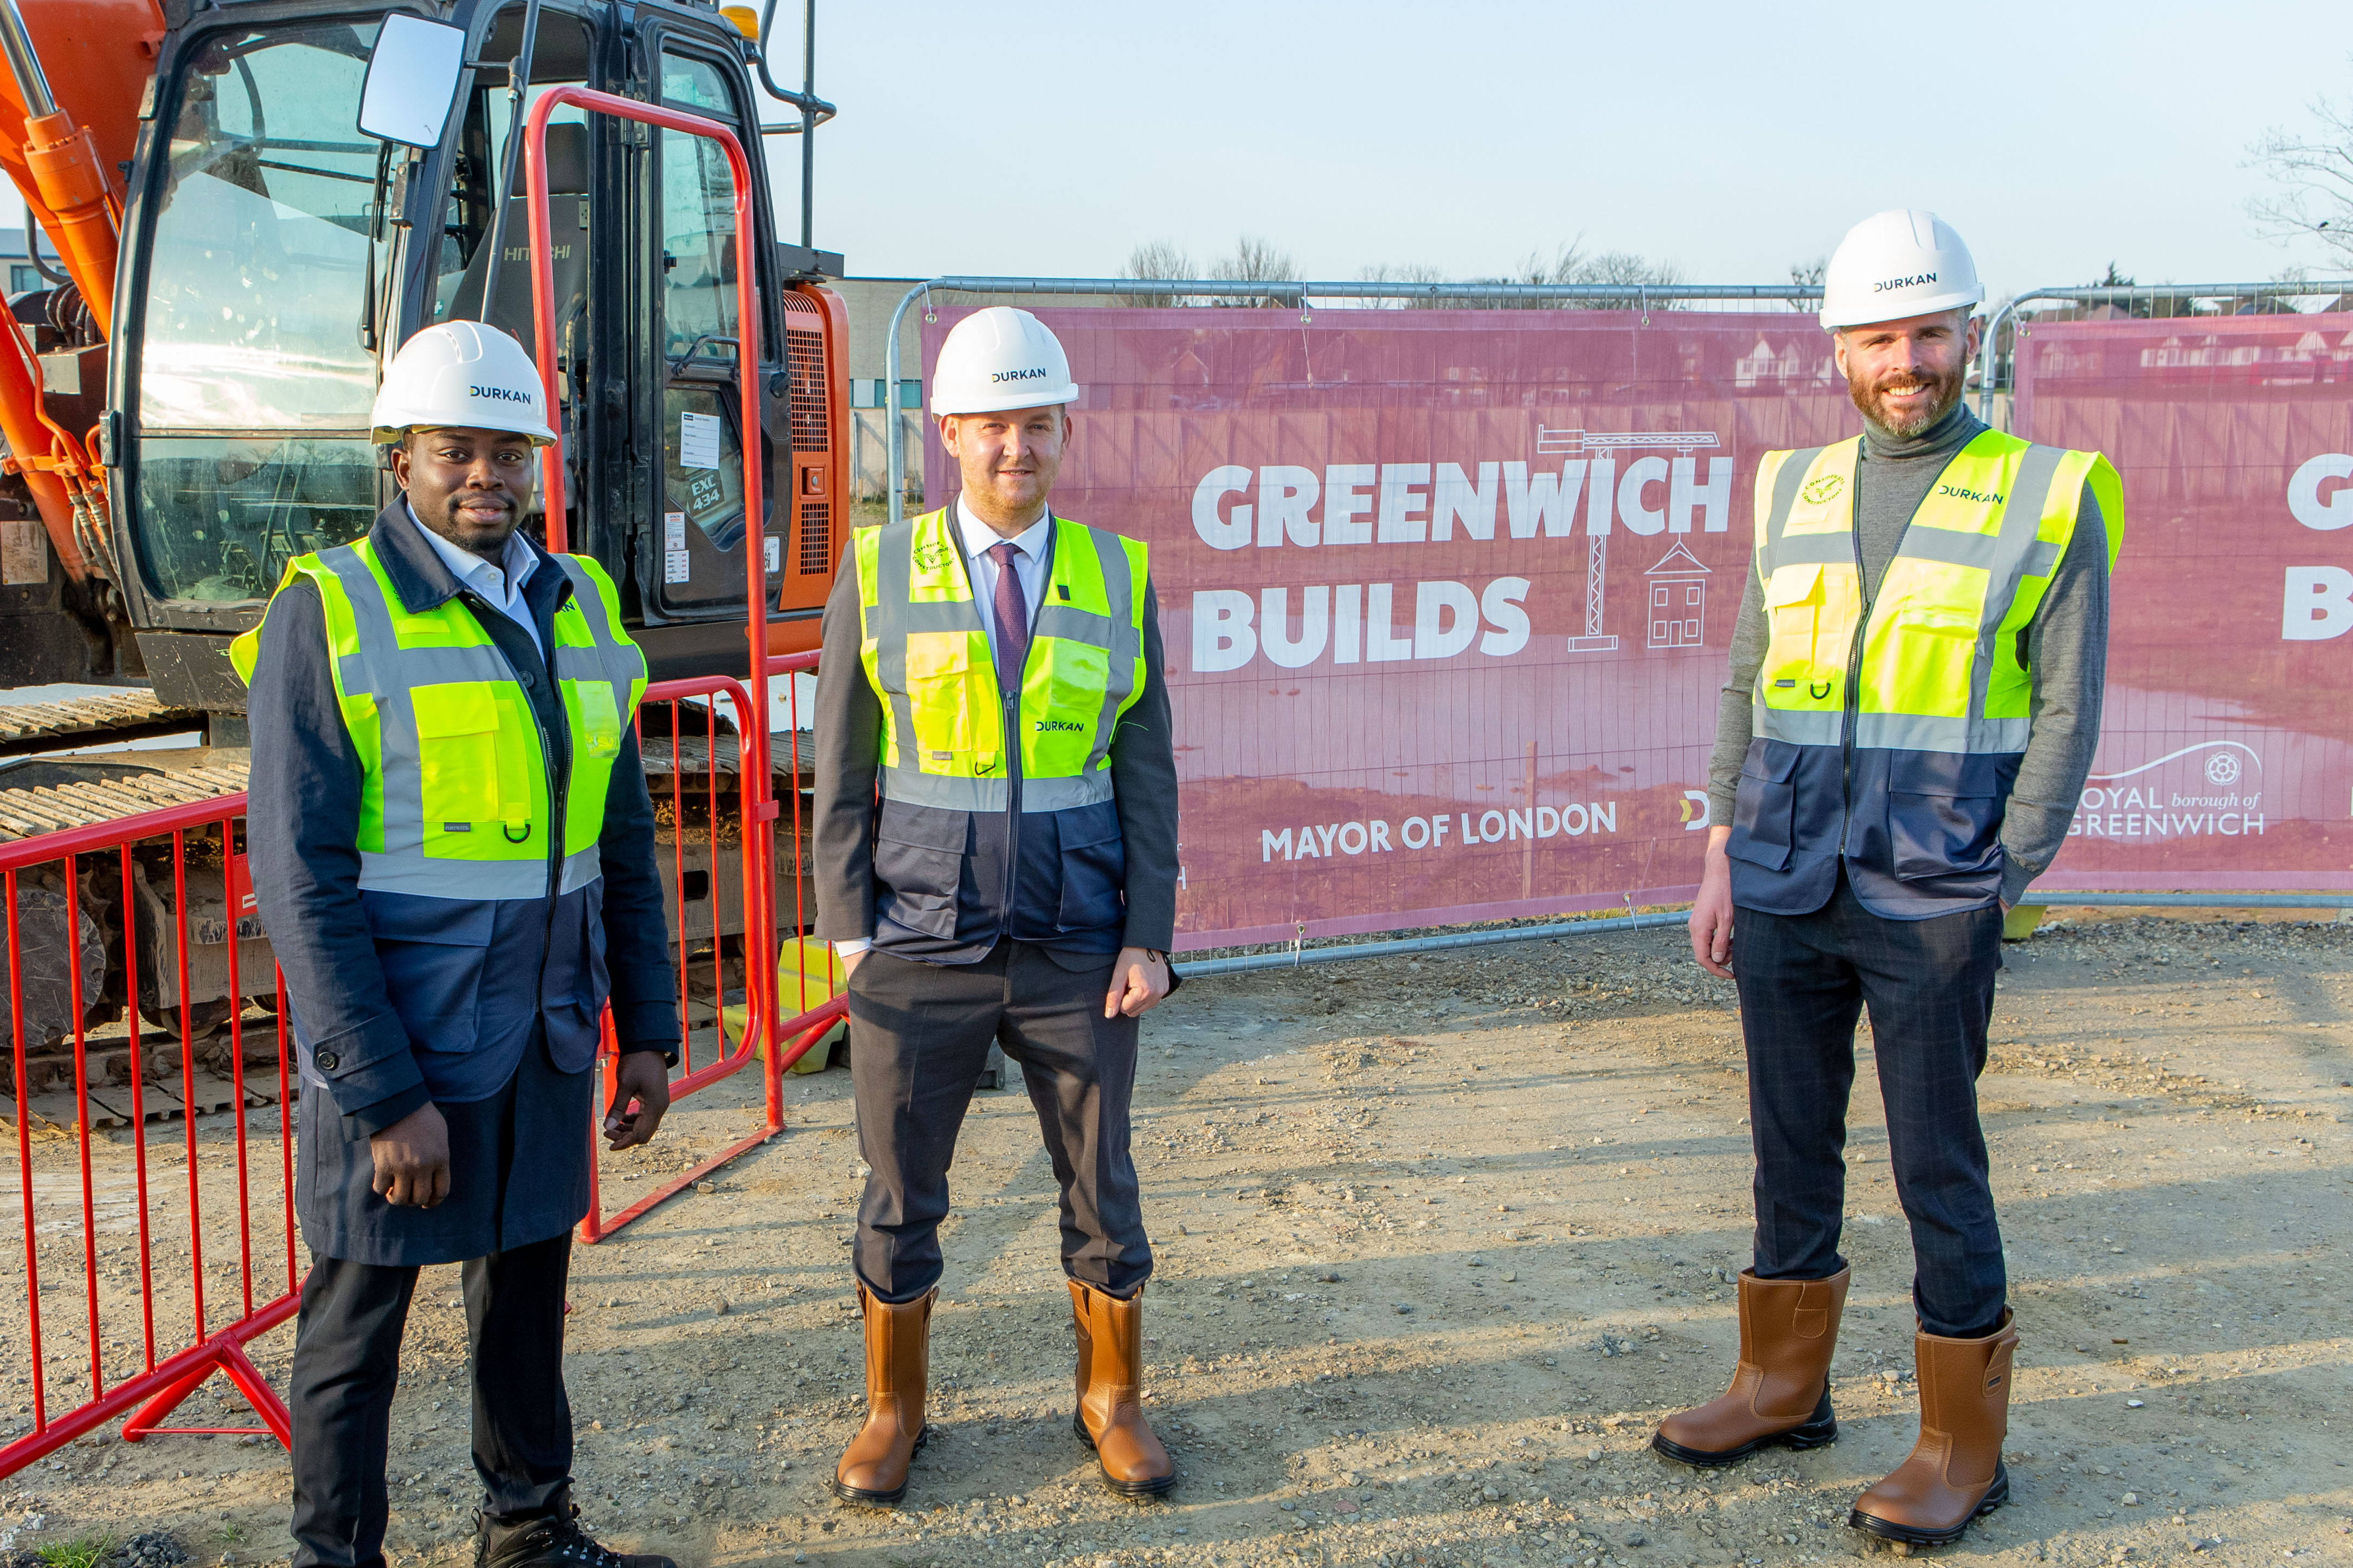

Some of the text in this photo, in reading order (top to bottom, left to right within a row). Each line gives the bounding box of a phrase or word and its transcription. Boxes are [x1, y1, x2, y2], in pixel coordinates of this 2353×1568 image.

[504, 245, 570, 260] HITHI
[1874, 272, 1937, 293] DURKAN
[991, 368, 1046, 383] DURKAN
[469, 385, 531, 405] DURKAN
[691, 474, 716, 496] EXC
[1938, 485, 2004, 505] DURKAN
[693, 488, 721, 509] 434
[1192, 456, 1733, 551] GREENWICH
[1192, 576, 1532, 672] BUILDS
[1034, 721, 1084, 732] DURKAN
[2075, 787, 2262, 810] OYAL borough of
[1261, 801, 1617, 862] MAYOR OF LONDON
